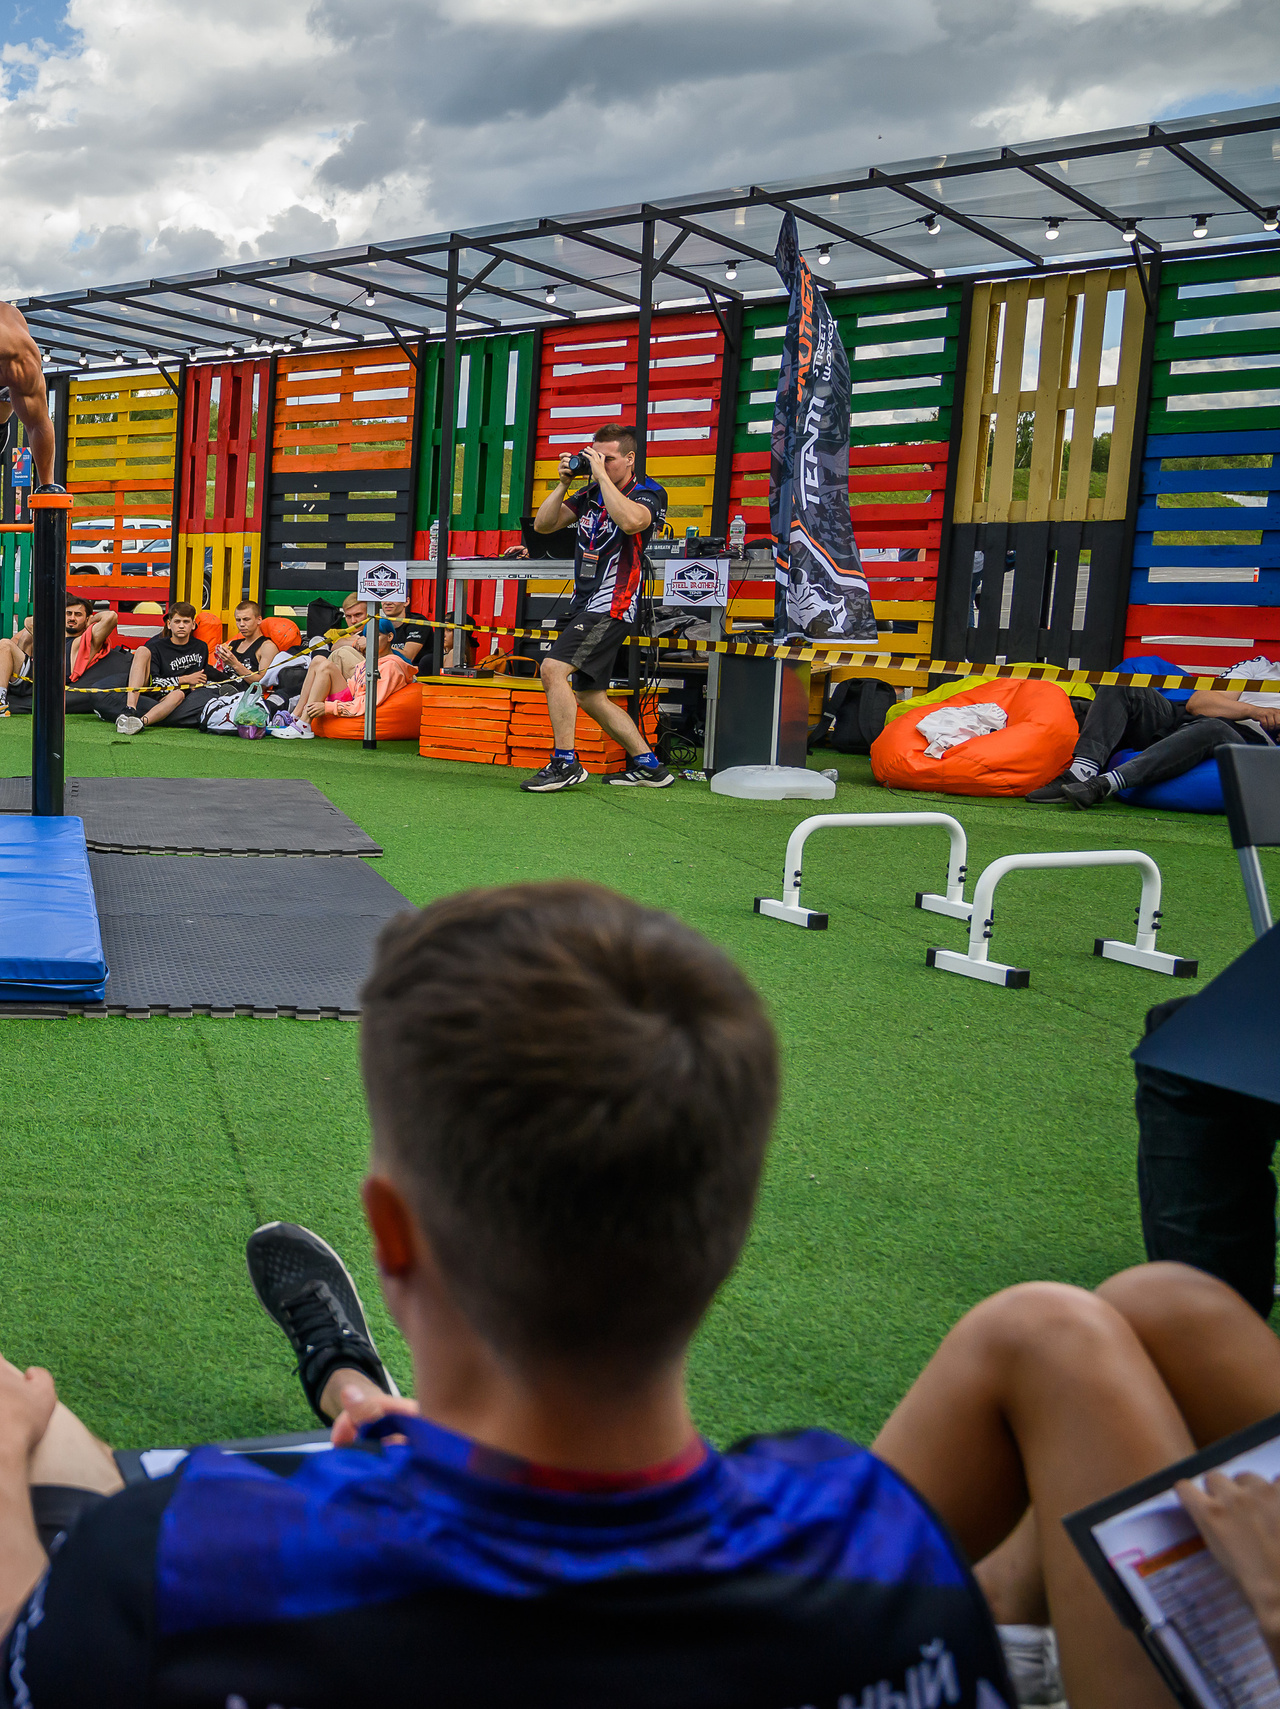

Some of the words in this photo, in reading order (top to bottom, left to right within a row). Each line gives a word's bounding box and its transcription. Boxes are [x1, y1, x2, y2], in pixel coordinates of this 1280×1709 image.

[813, 318, 827, 378] STREET
[800, 395, 826, 511] TEAM
[672, 581, 688, 589] STEEL
